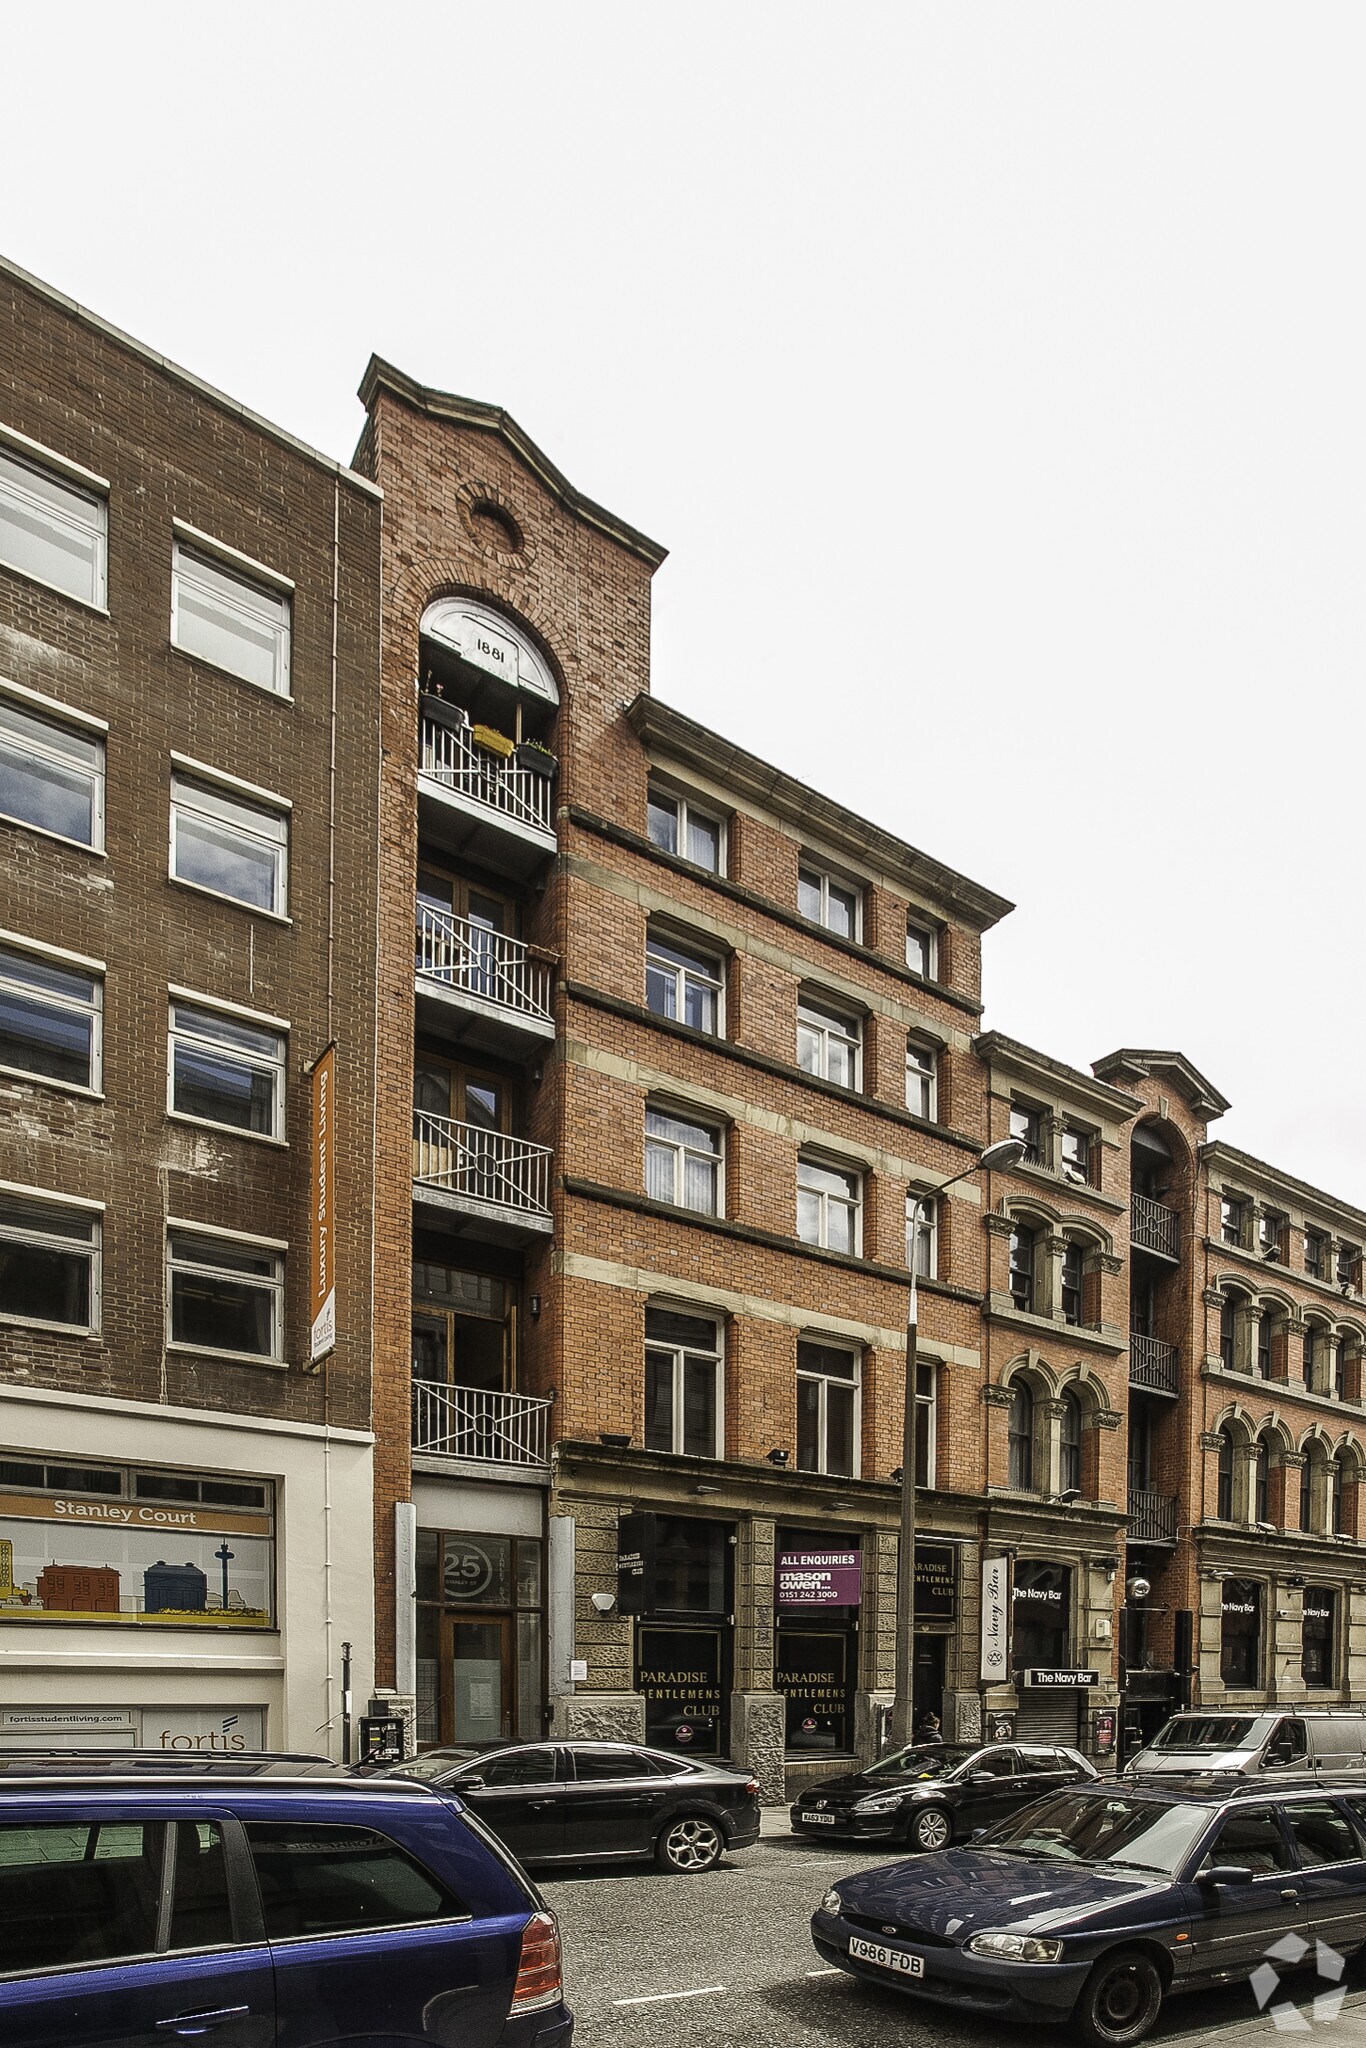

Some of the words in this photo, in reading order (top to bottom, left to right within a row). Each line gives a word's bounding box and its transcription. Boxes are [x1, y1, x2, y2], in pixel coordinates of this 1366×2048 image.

[477, 638, 505, 663] 1881
[318, 1070, 328, 1138] Living
[318, 1139, 327, 1221] Student
[318, 1226, 328, 1298] Luxury
[54, 1500, 133, 1522] Stanley
[138, 1507, 197, 1524] Court
[444, 1553, 480, 1578] 25
[780, 1556, 799, 1565] ALL
[800, 1555, 855, 1565] ENQUIRIES
[913, 1562, 947, 1573] ARADISE
[780, 1572, 831, 1581] mason
[987, 1566, 999, 1600] Bar
[931, 1587, 954, 1596] CLUB
[1013, 1588, 1027, 1598] The
[1027, 1589, 1048, 1600] Navy
[1048, 1590, 1062, 1600] Bar
[1221, 1602, 1229, 1611] he
[1228, 1603, 1244, 1613] Navy
[1244, 1604, 1255, 1612] Bar
[986, 1602, 1004, 1647] Navy
[640, 1671, 709, 1683] PARADISE
[776, 1672, 835, 1683] PARADISE
[1037, 1672, 1054, 1683] The
[1054, 1672, 1076, 1685] Navy
[1077, 1673, 1093, 1683] Bar
[683, 1705, 720, 1716] CLUB
[813, 1703, 846, 1714] CLUB
[9, 1714, 123, 1724] fortisstudentliving.com
[159, 1730, 246, 1750] fortis
[851, 1938, 887, 1963] V986
[889, 1951, 921, 1974] FDB
